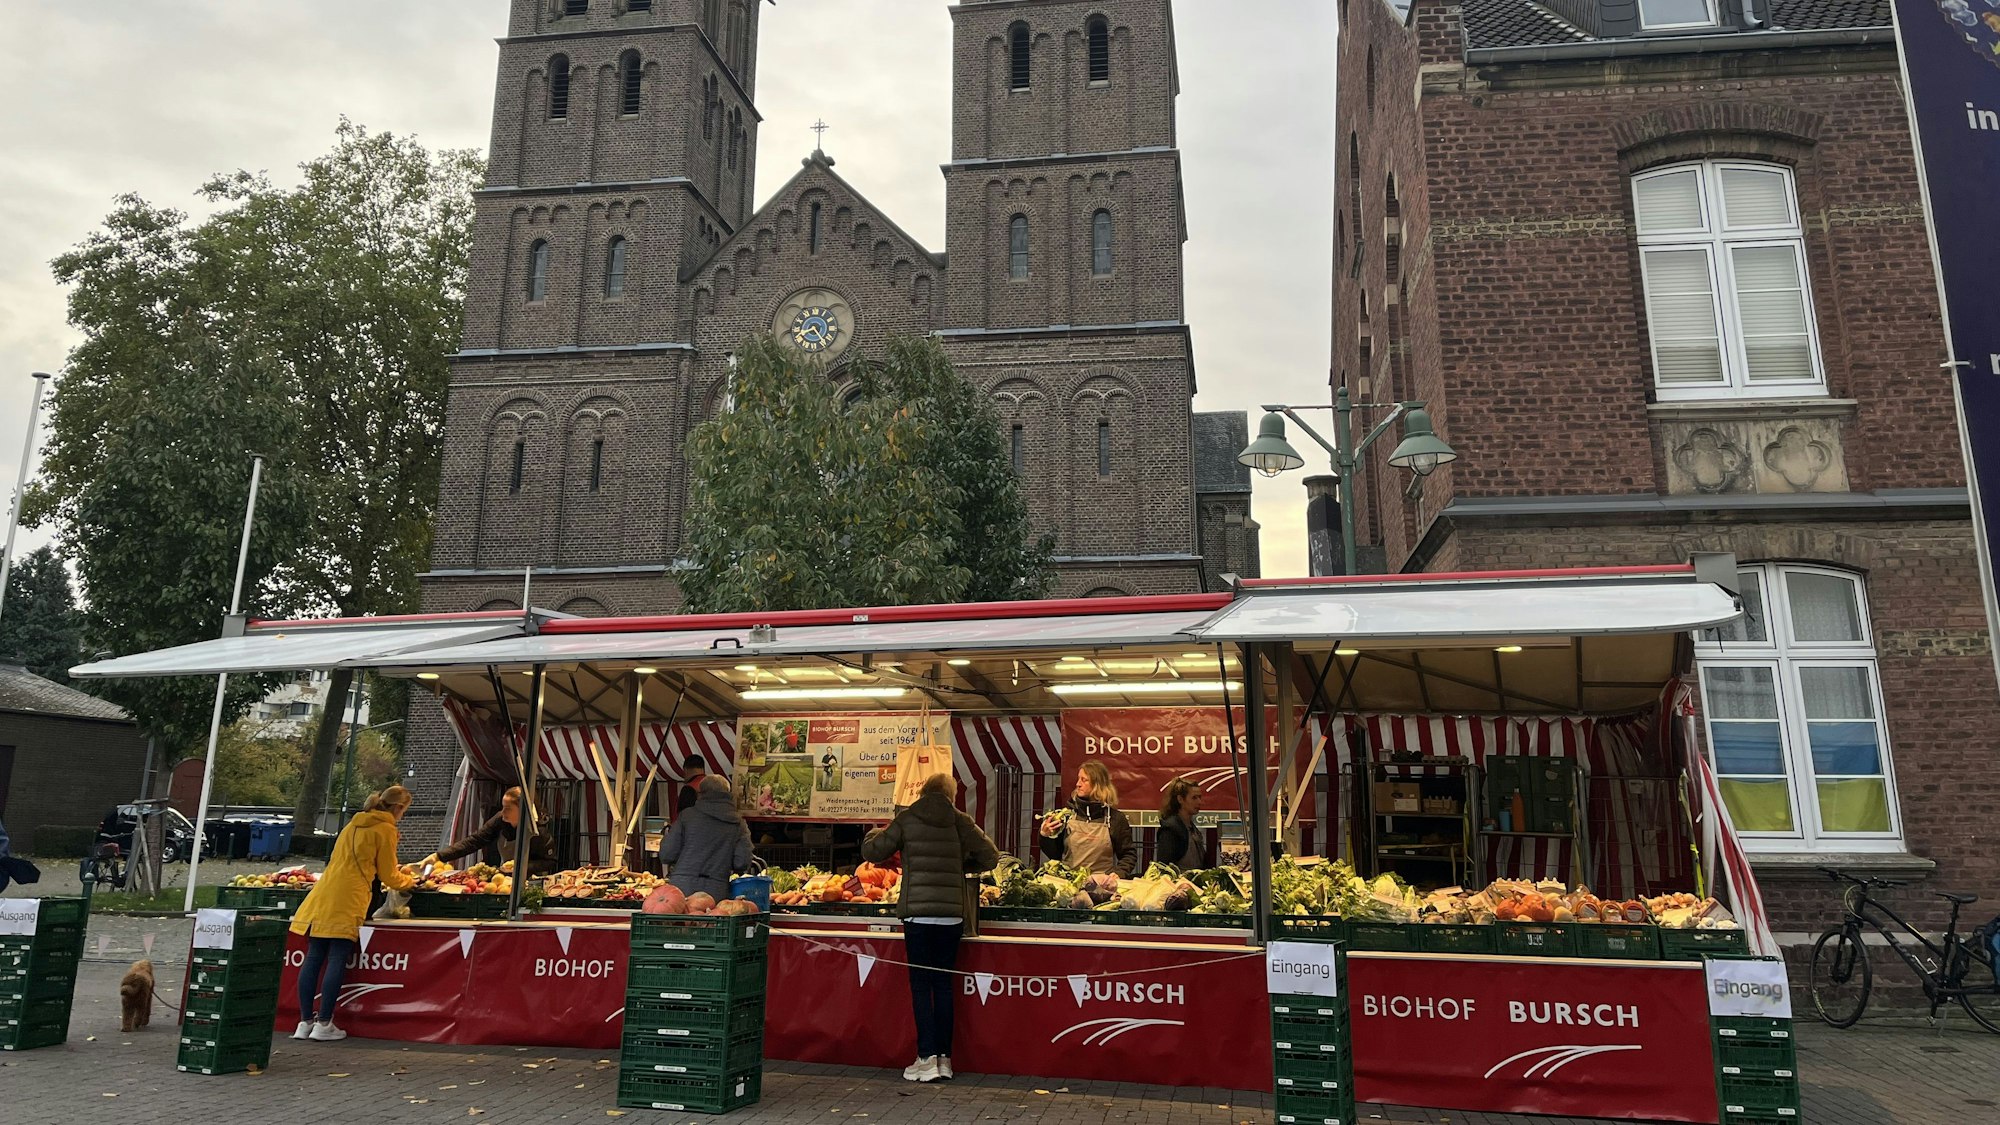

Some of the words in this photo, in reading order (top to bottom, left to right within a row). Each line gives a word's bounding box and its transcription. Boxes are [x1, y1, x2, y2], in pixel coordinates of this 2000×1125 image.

[1085, 736, 1173, 754] BIOHOF
[1184, 736, 1280, 754] BURSH
[845, 770, 876, 779] eigenem
[0, 911, 36, 923] Ausgang
[196, 922, 232, 936] Ausgang
[345, 953, 409, 970] URSCH
[535, 958, 614, 978] BIOHOF
[1272, 959, 1330, 978] Eingang
[964, 976, 1058, 997] BOHOF
[1714, 979, 1783, 1002] Eingang
[1363, 995, 1475, 1020] BIOHOF
[1509, 1001, 1639, 1028] BURSCH
